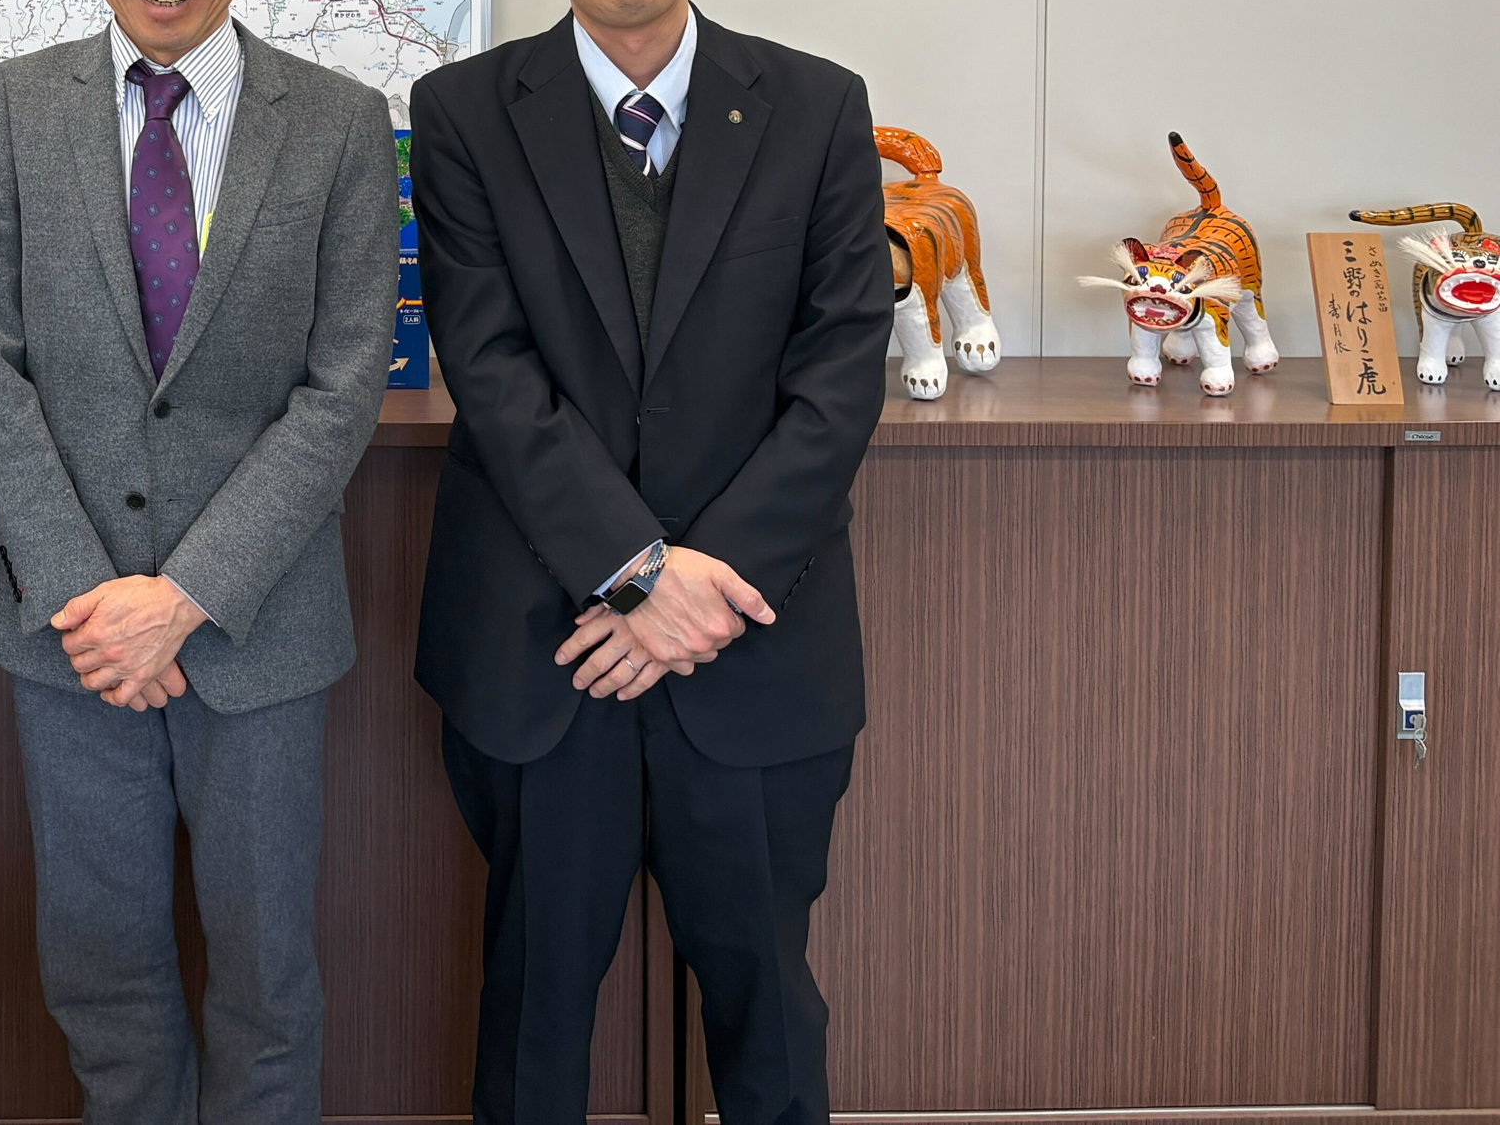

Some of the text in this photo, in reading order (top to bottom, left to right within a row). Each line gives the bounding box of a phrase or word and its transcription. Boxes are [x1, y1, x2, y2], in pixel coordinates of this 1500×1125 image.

[1342, 240, 1387, 395] 三野のはりこ虎
